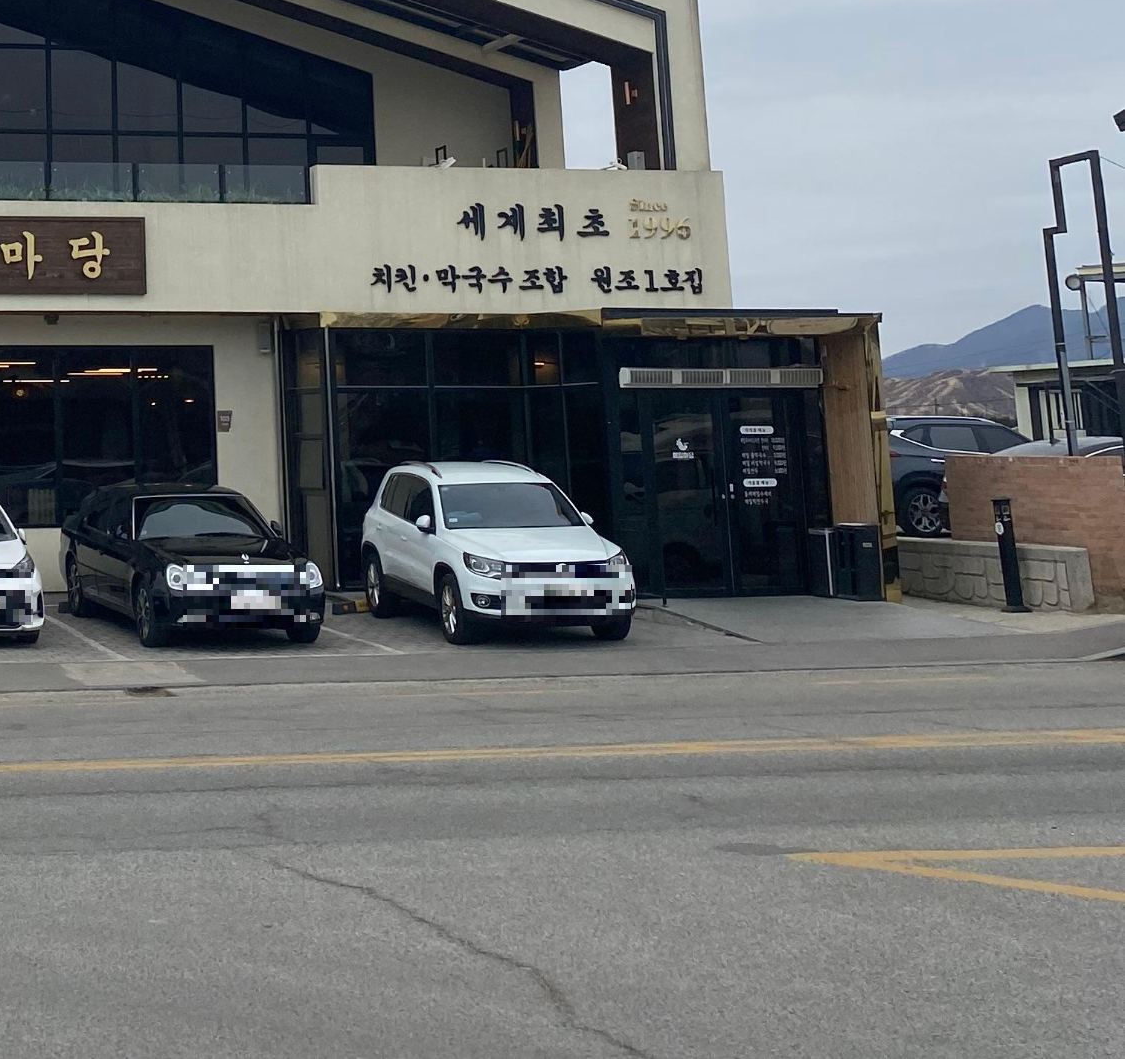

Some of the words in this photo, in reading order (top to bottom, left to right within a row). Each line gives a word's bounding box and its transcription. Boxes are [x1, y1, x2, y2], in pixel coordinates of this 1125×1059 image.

[629, 198, 668, 212] Since
[457, 202, 610, 242] 세계최초
[628, 216, 692, 240] 1996
